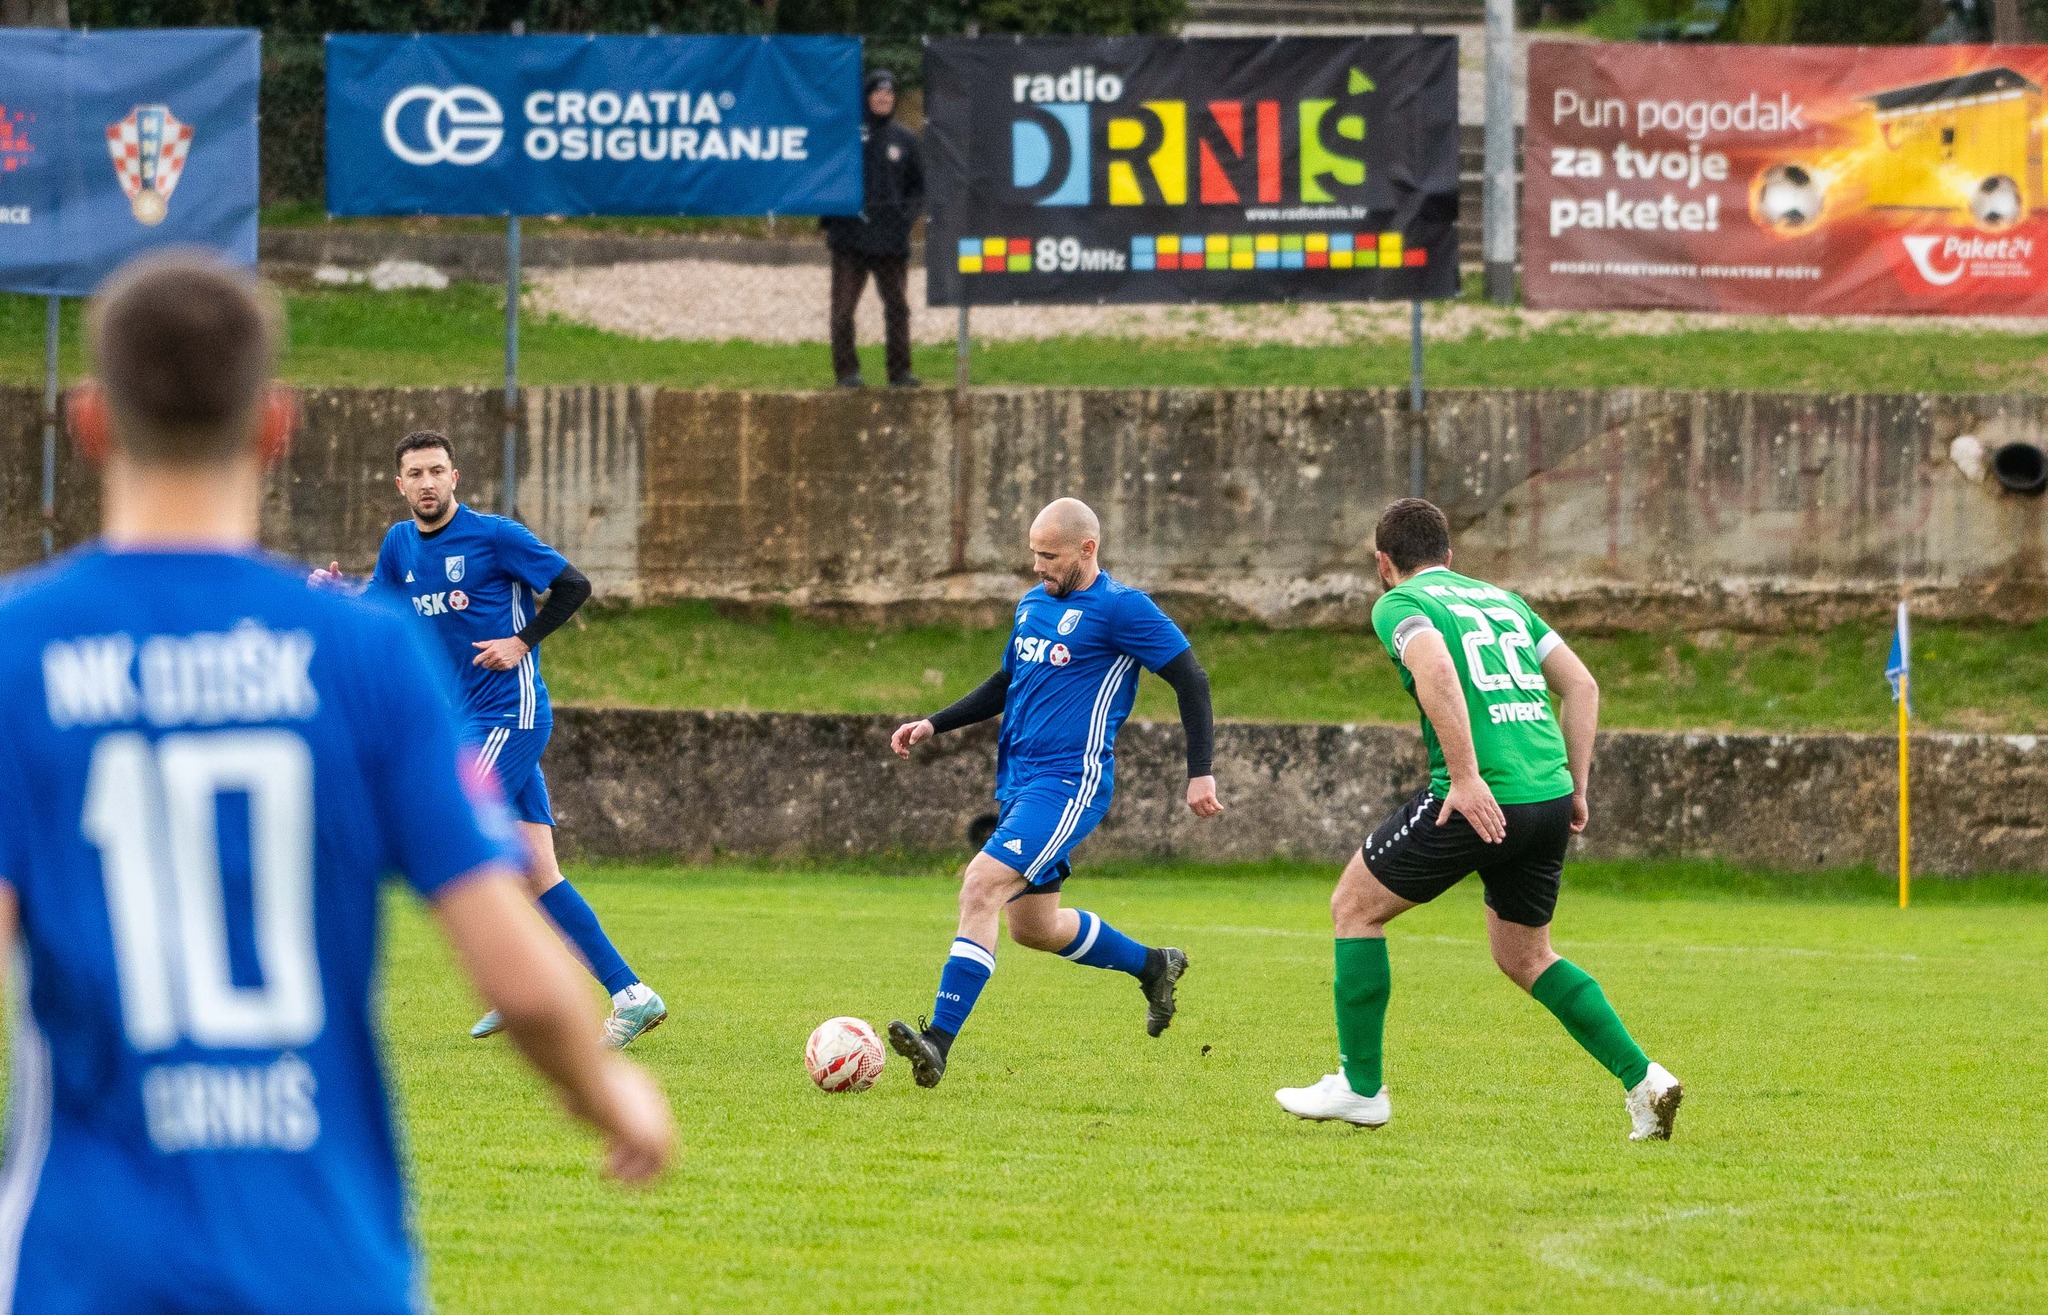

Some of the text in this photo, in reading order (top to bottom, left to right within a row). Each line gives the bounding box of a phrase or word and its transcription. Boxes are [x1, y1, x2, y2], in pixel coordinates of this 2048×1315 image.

[1013, 67, 1122, 101] radio
[1553, 89, 1803, 140] Pun pogodak
[524, 127, 807, 161] OSIGURANJE
[1551, 141, 1728, 189] za tvoje
[1550, 190, 1720, 237] pakete!
[1446, 604, 1547, 691] 22
[83, 731, 325, 1052] 10
